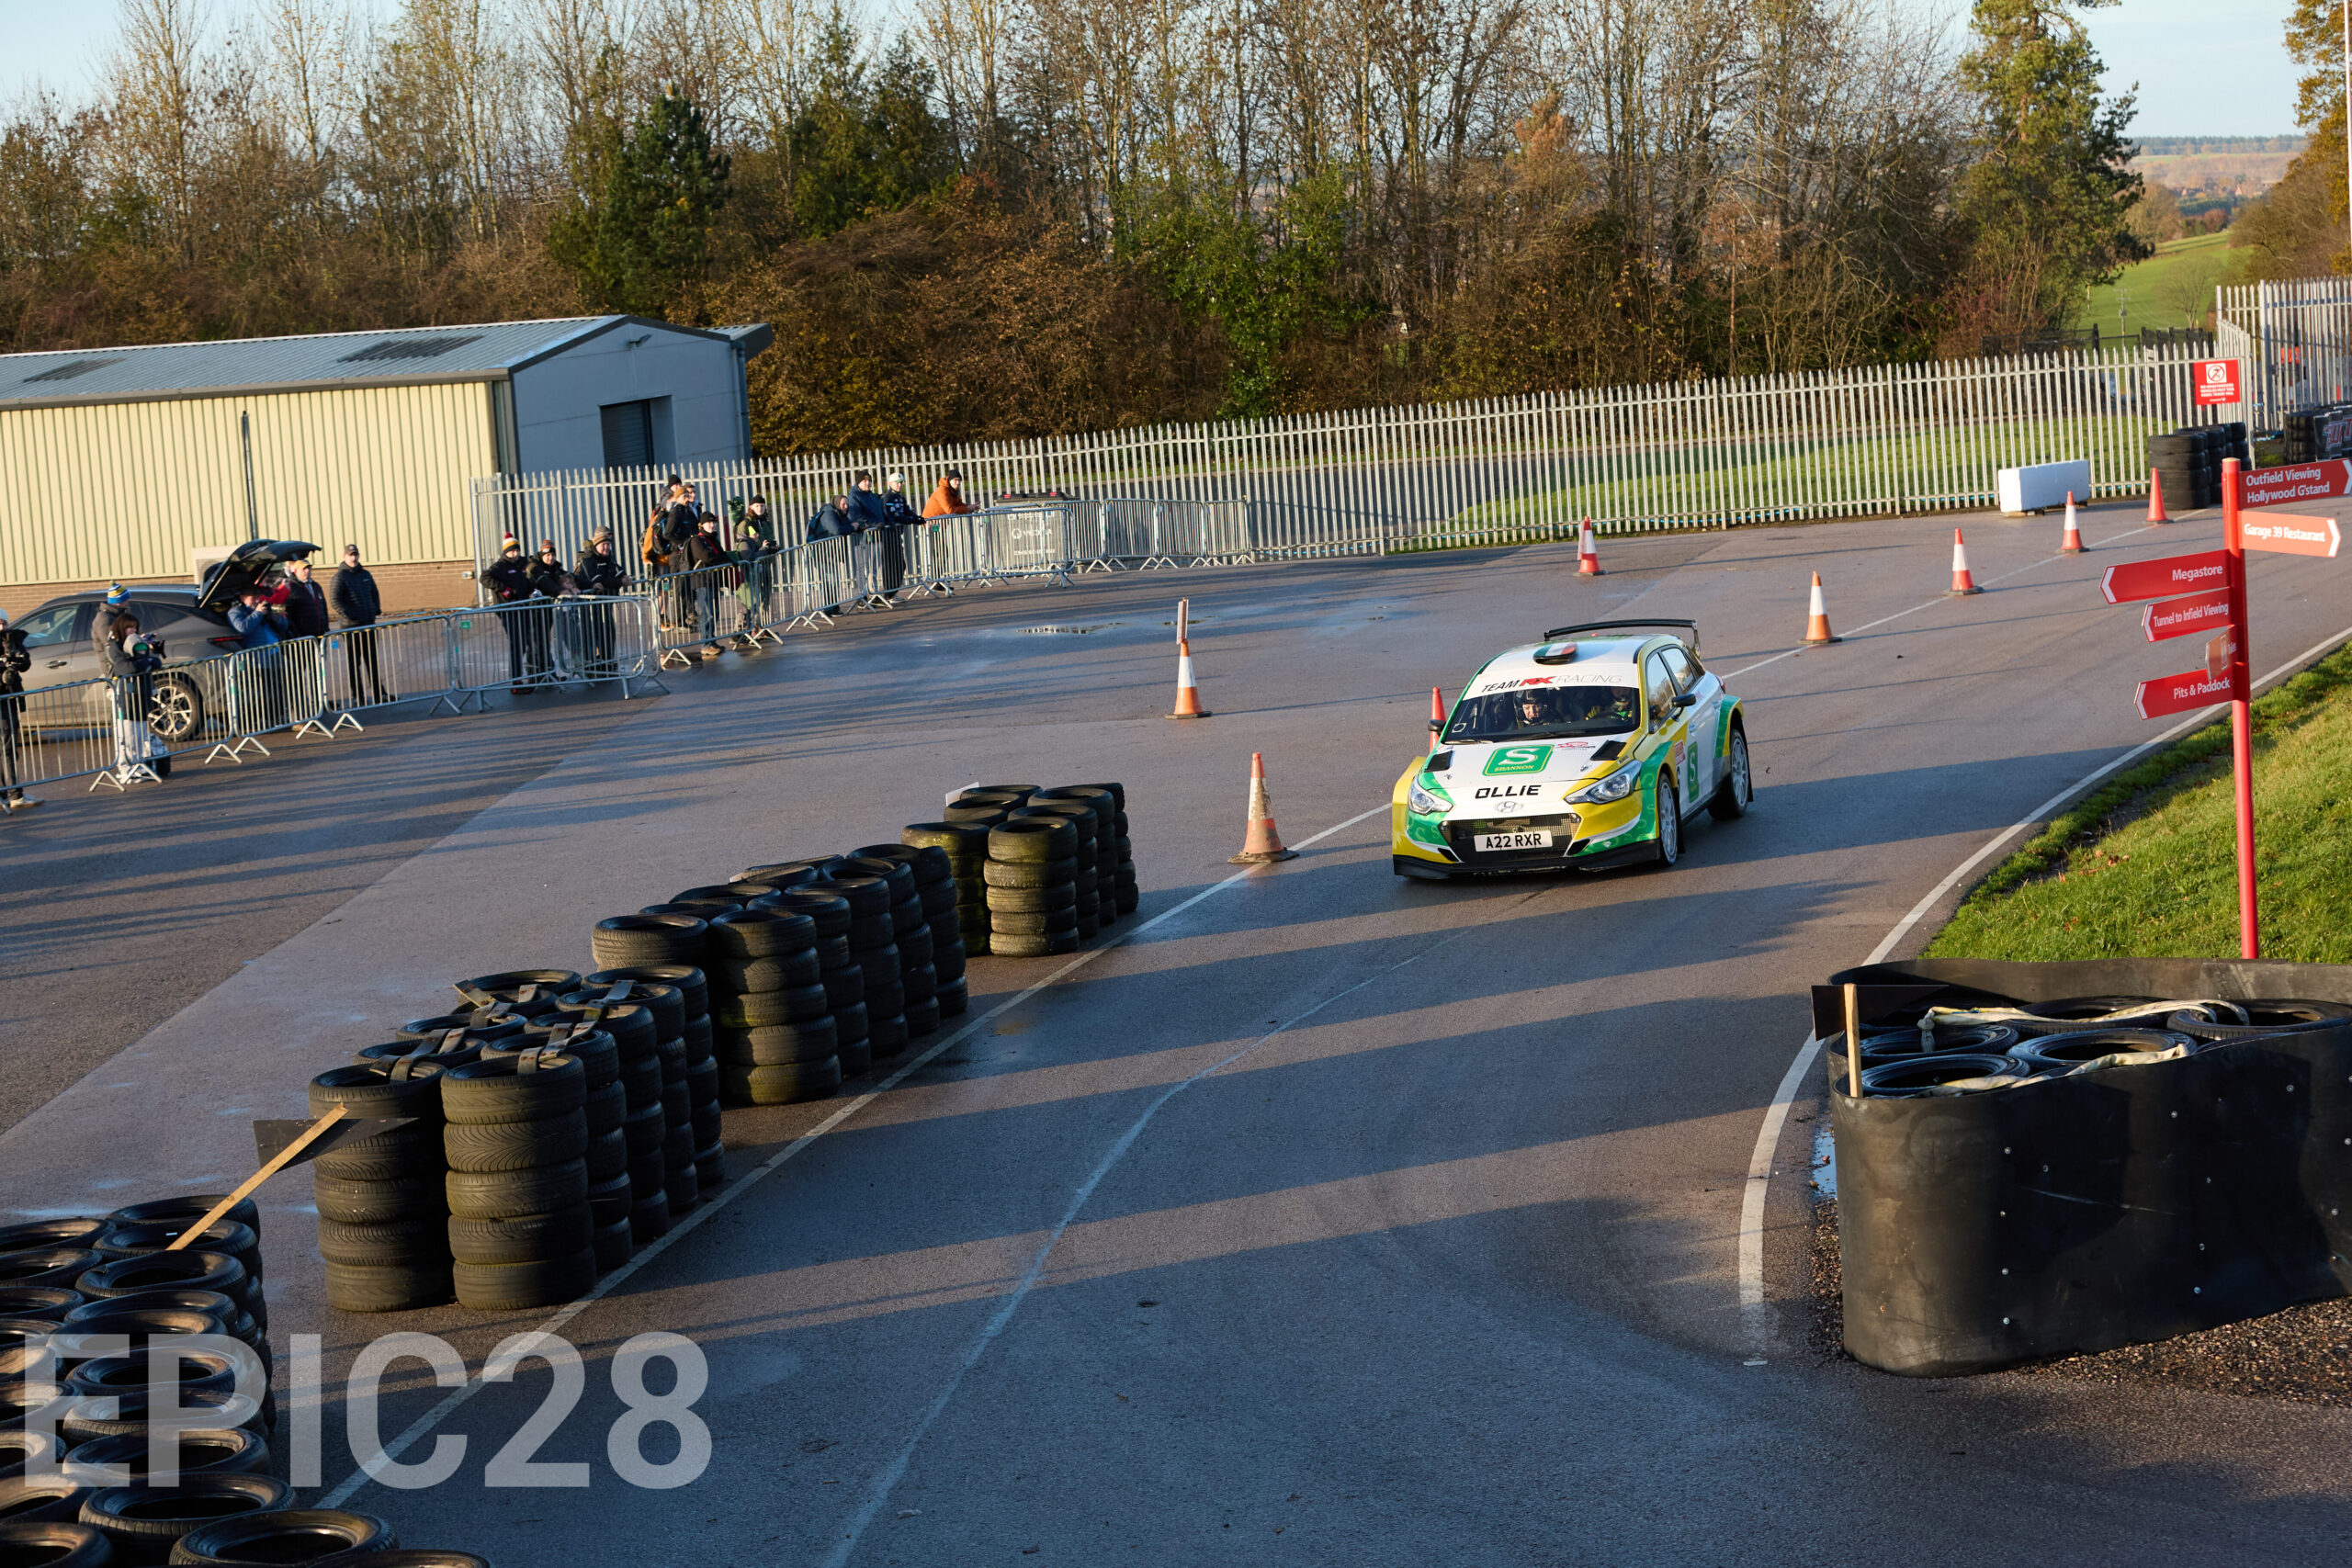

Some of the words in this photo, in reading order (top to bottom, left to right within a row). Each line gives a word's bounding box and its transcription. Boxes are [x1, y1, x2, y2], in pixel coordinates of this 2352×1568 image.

[2246, 469, 2283, 486] Outfield
[2285, 467, 2321, 480] Viewing
[2247, 486, 2295, 503] Hollywood
[2298, 481, 2330, 496] G'stand
[2244, 524, 2271, 540] Garage
[2273, 526, 2282, 538] 39
[2283, 526, 2325, 542] Restaurant
[2172, 566, 2222, 581] Megastore
[2153, 612, 2174, 627] Tunnel
[2176, 613, 2182, 623] to
[2183, 607, 2202, 621] Infield
[2204, 602, 2229, 615] Viewing
[1481, 680, 1521, 693] TEAM
[1557, 674, 1623, 683] RACING
[2174, 686, 2188, 699] Pits
[2189, 684, 2196, 695] &
[2198, 677, 2230, 694] Paddock
[1498, 748, 1541, 765] S
[1486, 835, 1511, 849] A22
[1515, 833, 1542, 847] RXR
